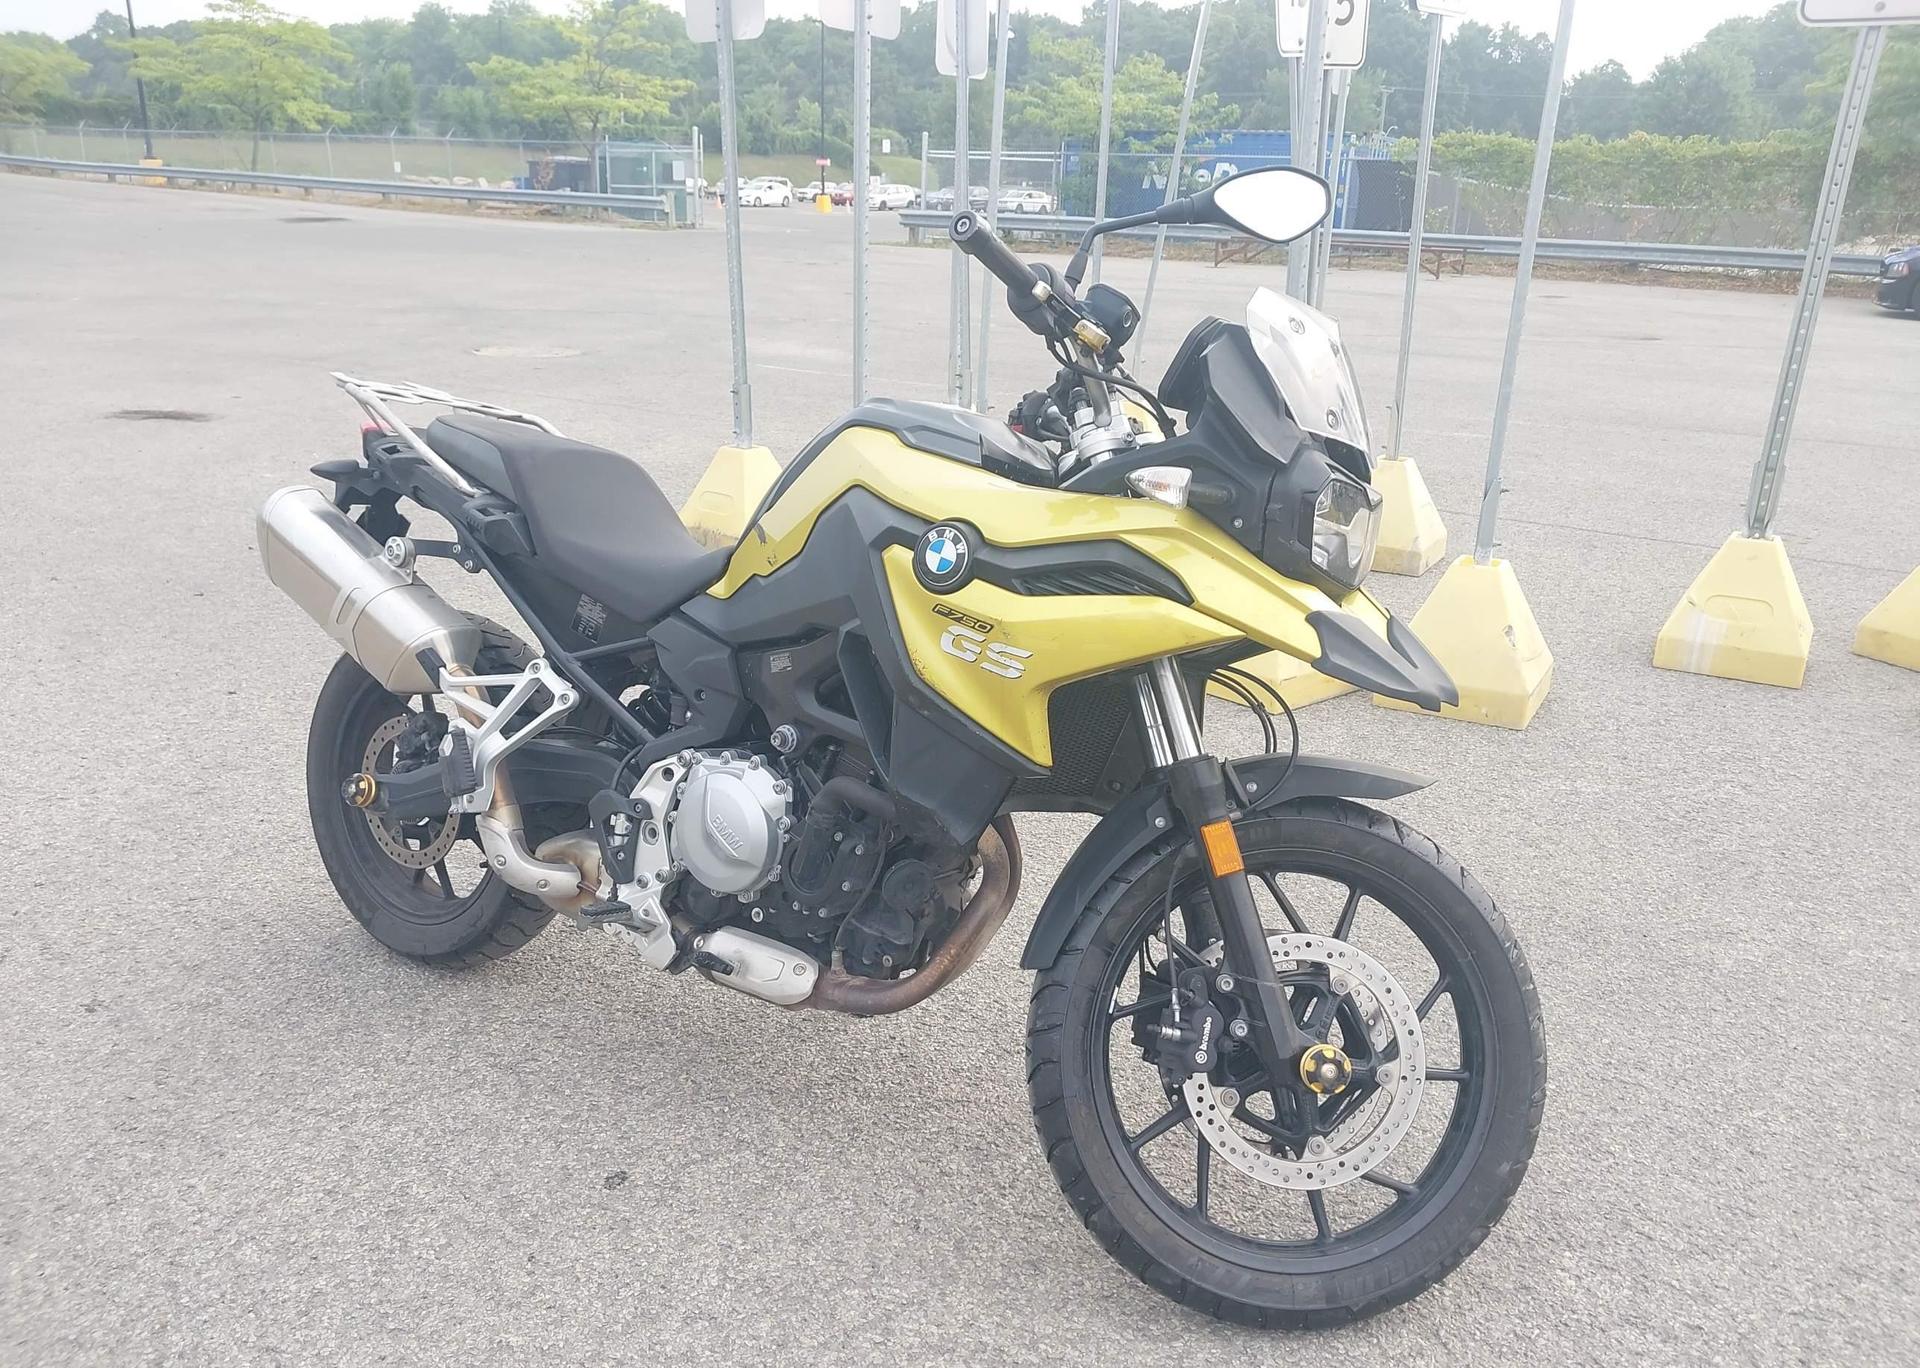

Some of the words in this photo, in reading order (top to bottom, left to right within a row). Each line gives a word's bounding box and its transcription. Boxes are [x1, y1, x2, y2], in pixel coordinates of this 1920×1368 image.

[928, 529, 966, 554] BMW
[934, 604, 991, 633] F750
[940, 625, 1034, 679] GS
[711, 814, 744, 850] BMW
[1199, 1016, 1212, 1051] brembo
